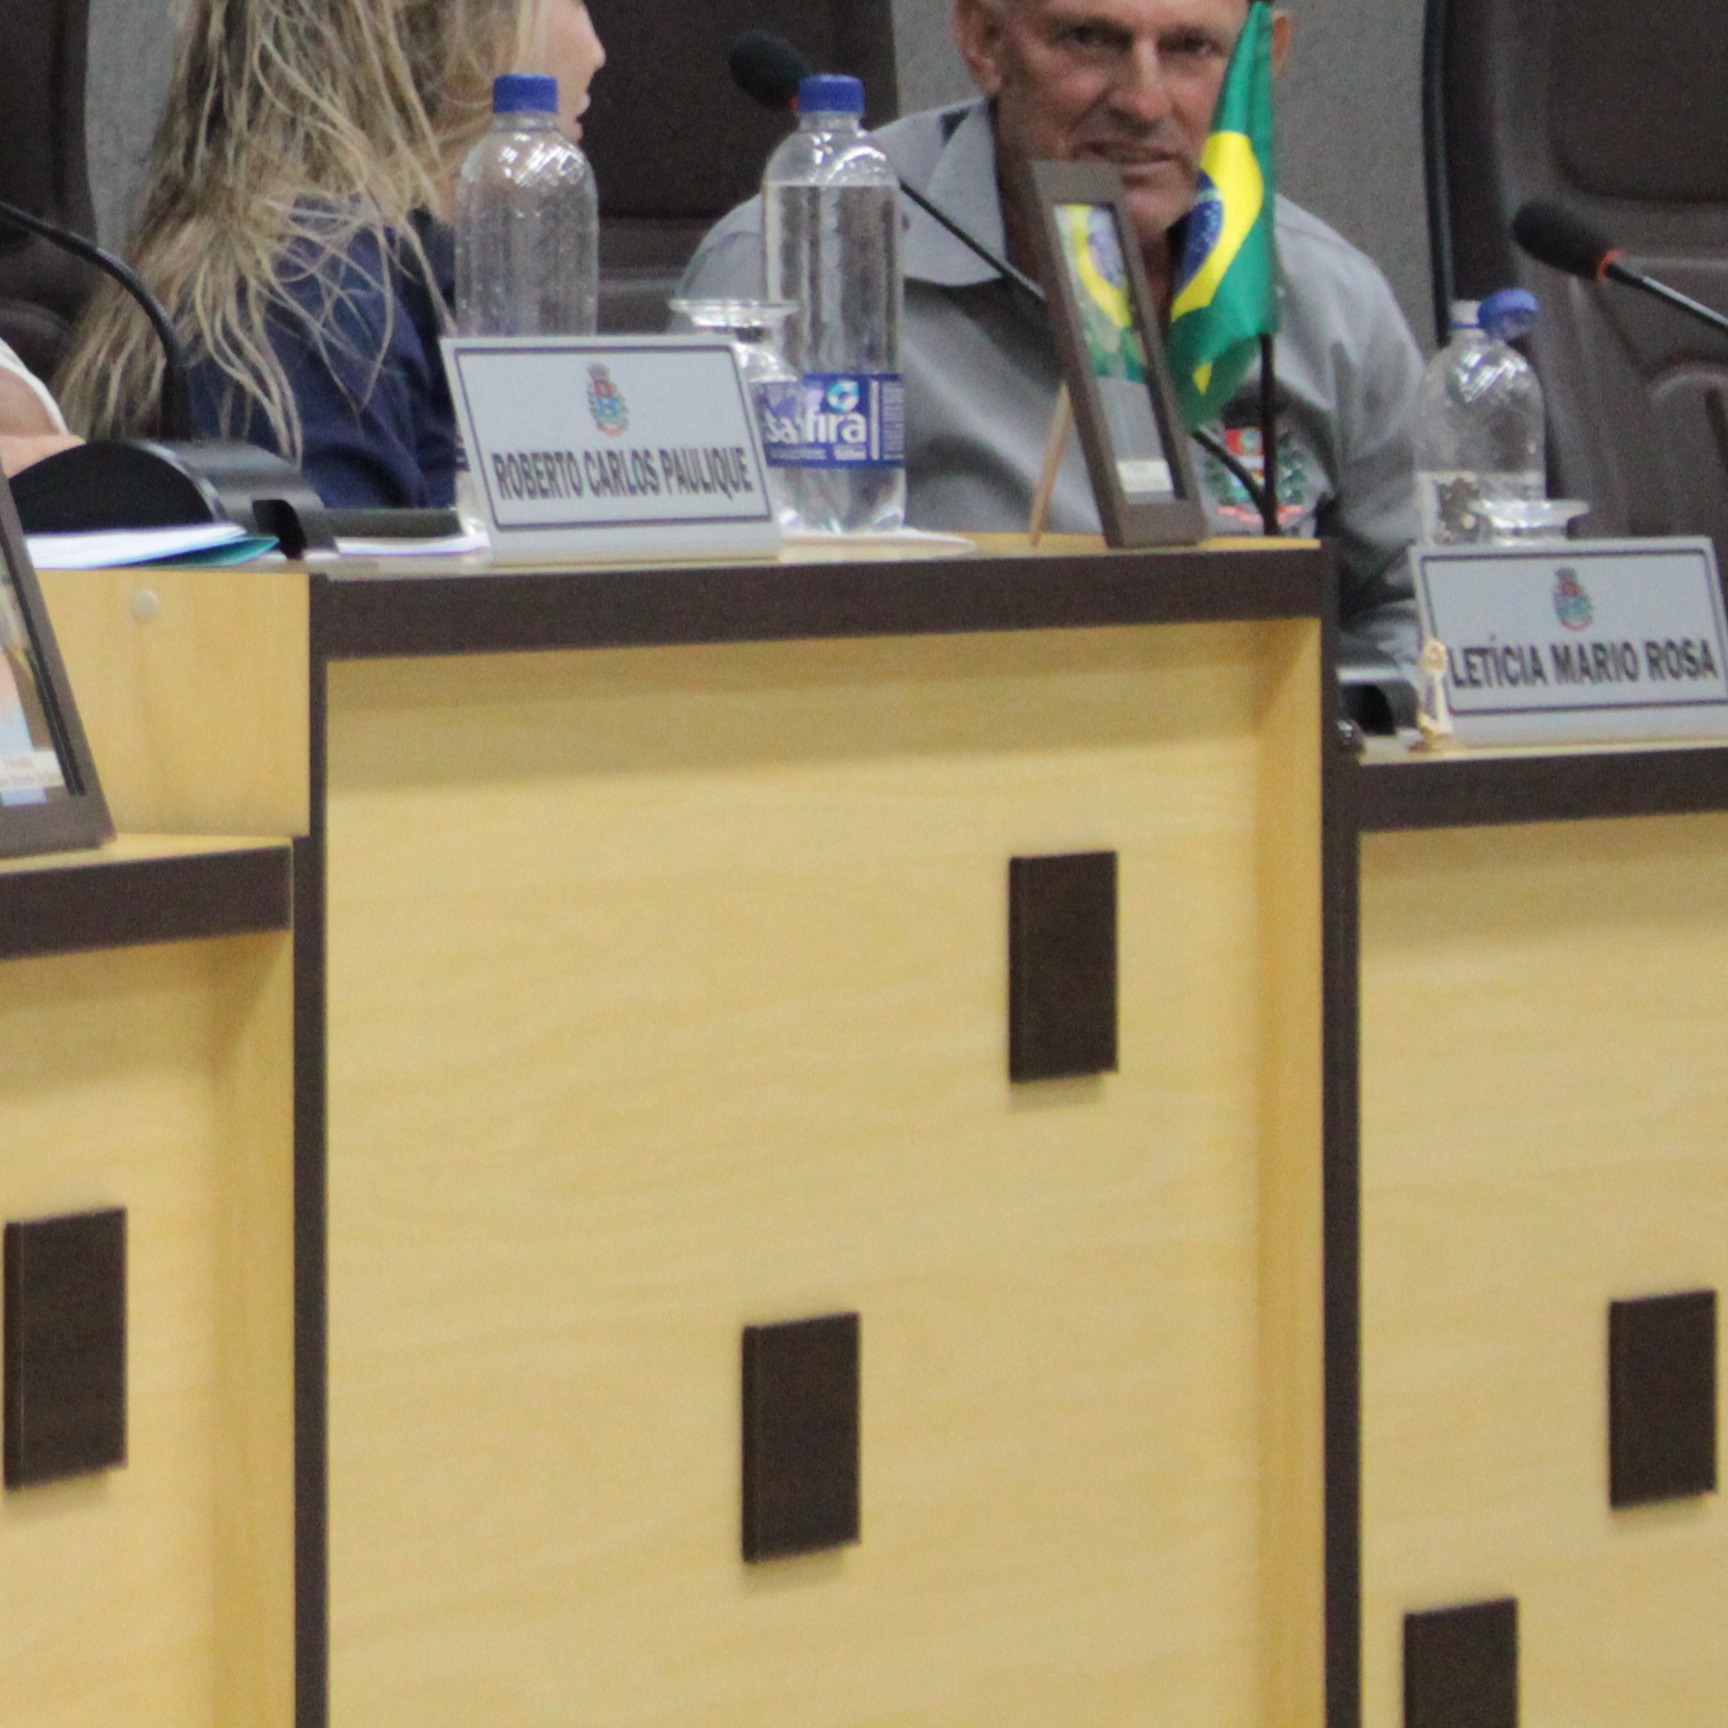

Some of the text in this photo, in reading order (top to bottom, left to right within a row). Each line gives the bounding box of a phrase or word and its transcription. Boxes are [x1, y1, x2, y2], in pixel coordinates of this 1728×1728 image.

[492, 447, 753, 500] ROBERTO CARLOS PAULIQUE
[1446, 632, 1718, 689] LETÍCIA MARIO ROSA
